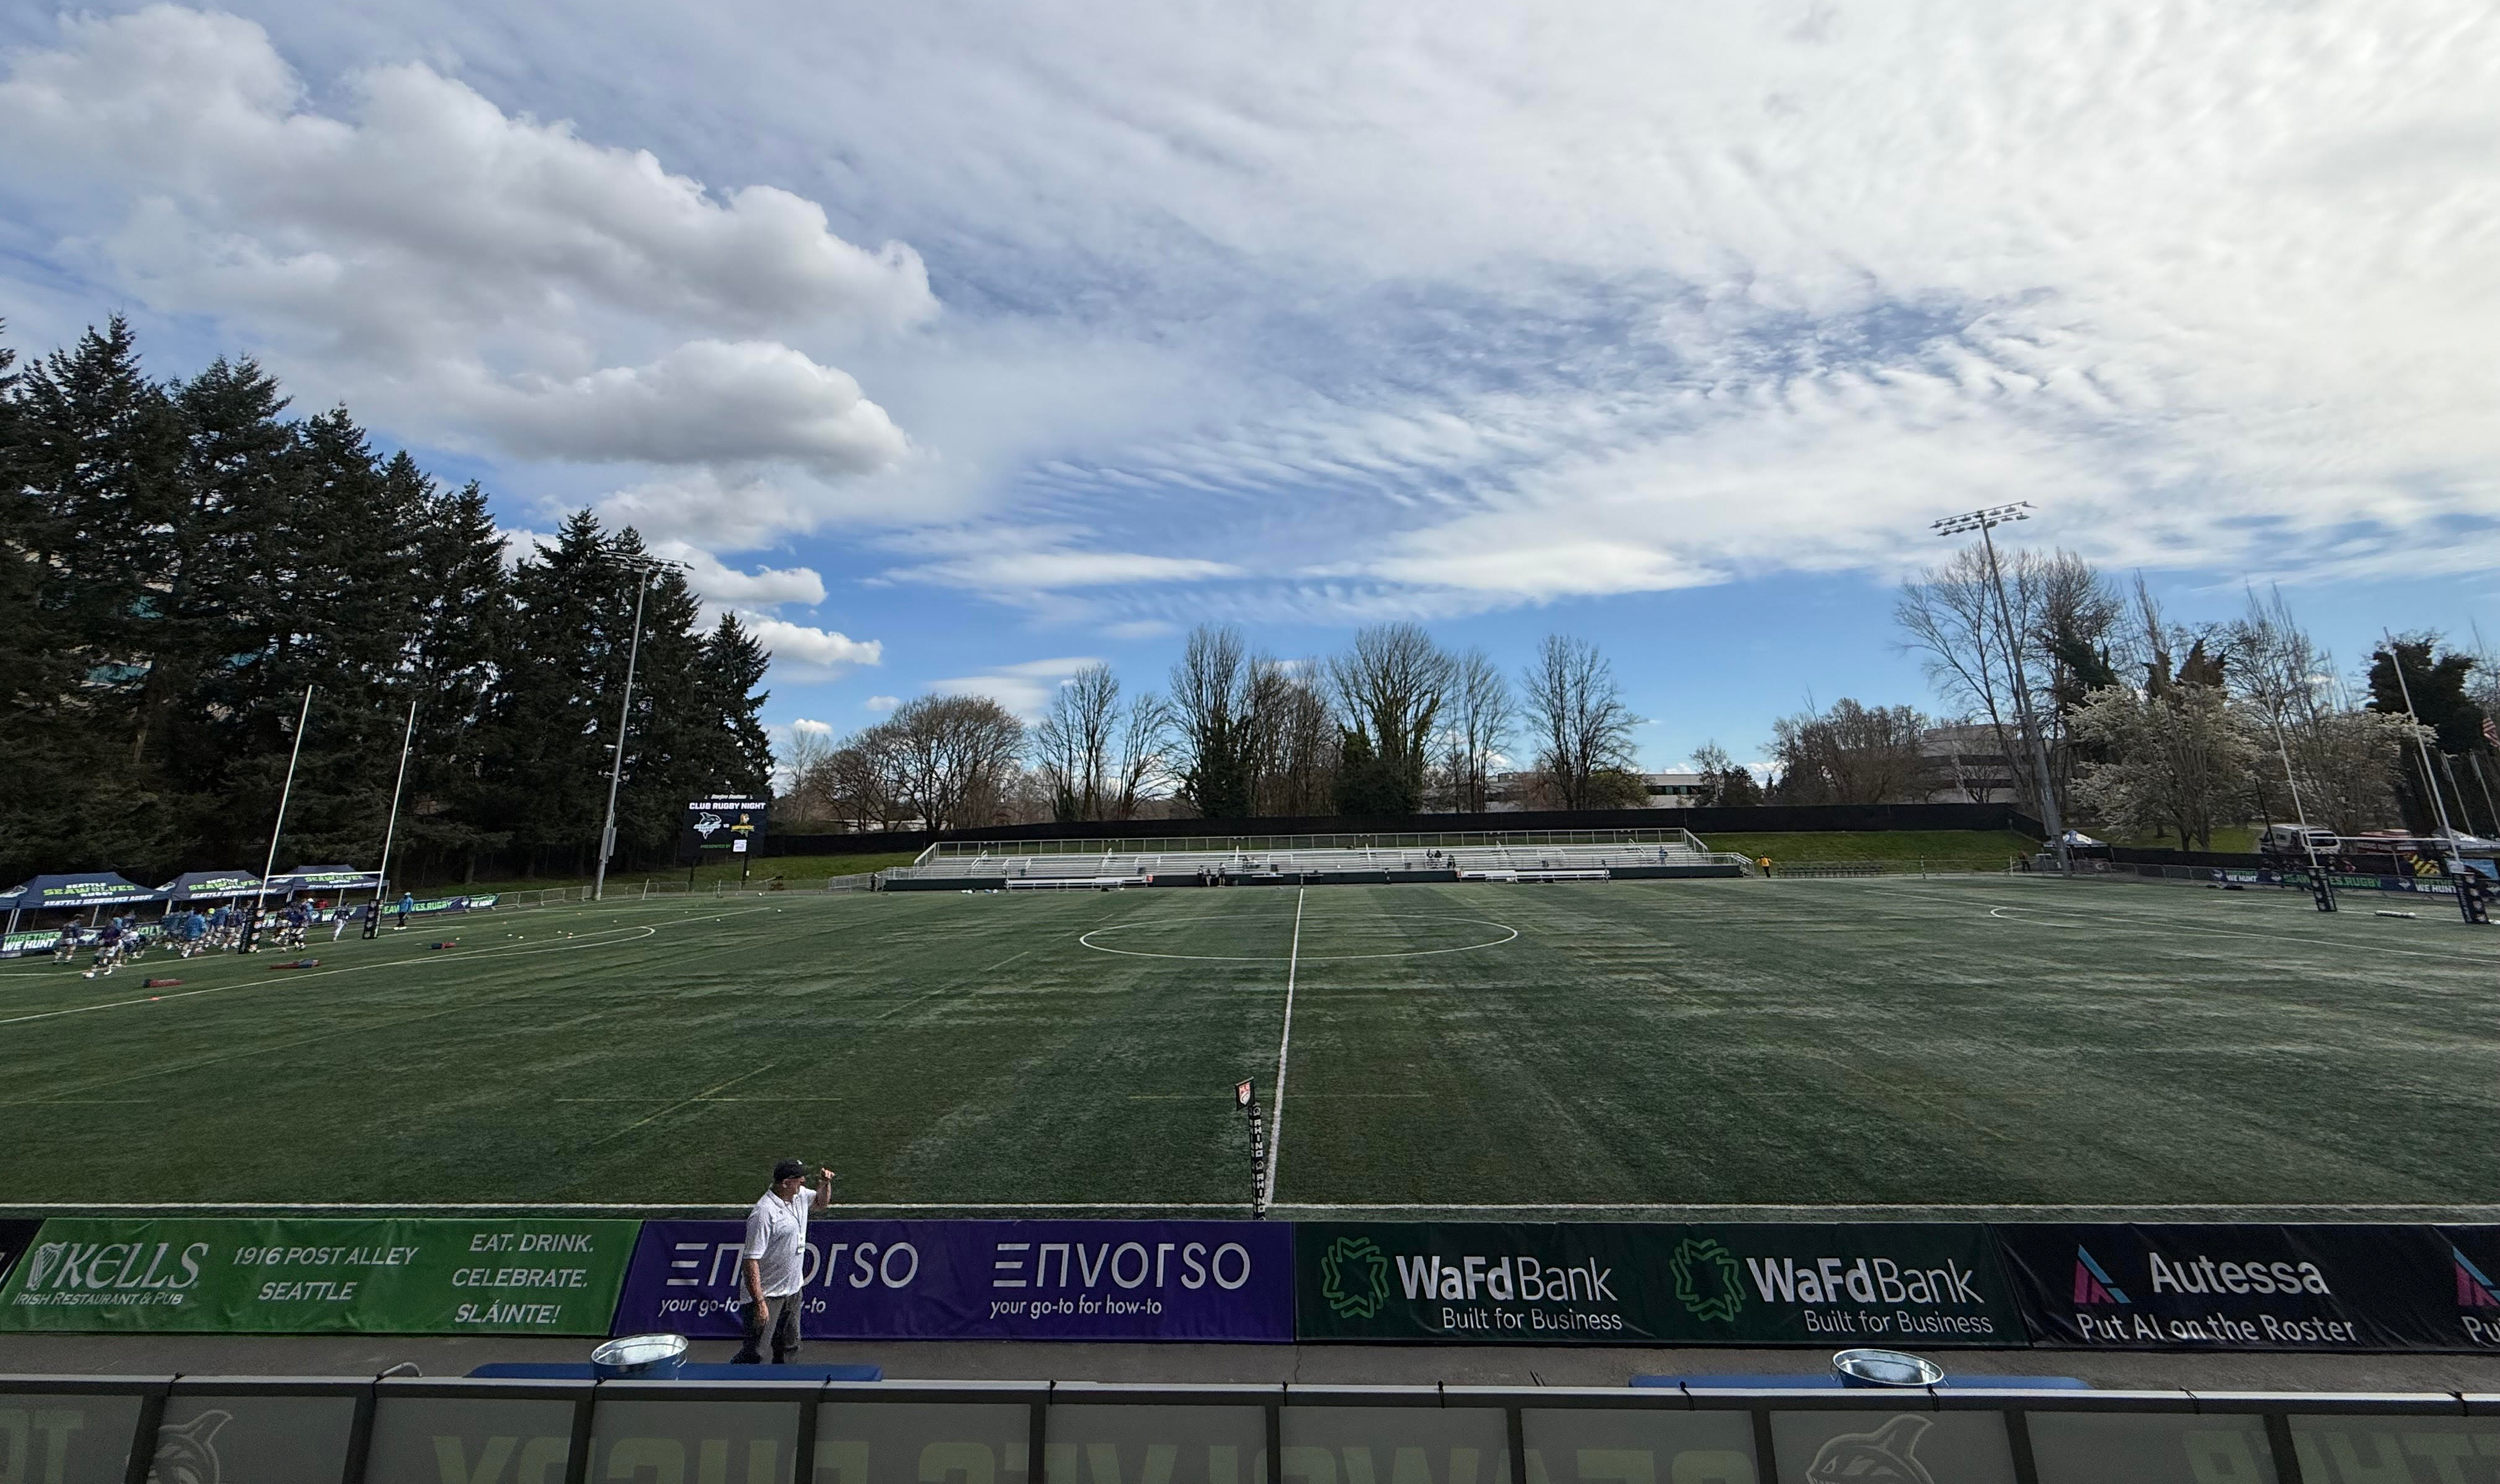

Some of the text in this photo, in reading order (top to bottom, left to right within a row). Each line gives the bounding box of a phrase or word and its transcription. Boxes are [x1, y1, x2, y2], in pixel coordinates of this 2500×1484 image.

[689, 802, 766, 810] CLUB RUGBY NIGHT
[2415, 883, 2430, 892] WE
[2, 939, 57, 951] WE HUNT
[1254, 1118, 1264, 1158] RHINO
[469, 1233, 594, 1252] EAT. DRINK.
[52, 1242, 209, 1289] KELLS
[233, 1246, 420, 1265] 1916 POST ALLEY
[452, 1268, 588, 1288] CELEBRATE.
[2148, 1252, 2331, 1295] Autessa
[52, 1291, 142, 1306] RESTAURANT
[141, 1292, 152, 1305] &
[152, 1292, 184, 1305] PUB
[258, 1281, 358, 1301] SEATTLE
[454, 1299, 561, 1324] SLÁINTE!
[658, 1297, 697, 1317] your
[698, 1297, 740, 1317] go-to
[990, 1294, 1162, 1319] your go-to for how-to
[1442, 1307, 1623, 1331] Built for Business
[1803, 1309, 1994, 1334] Built for Business
[2075, 1312, 2129, 1343] Put
[2169, 1319, 2207, 1340] on
[2207, 1312, 2260, 1341] the
[2258, 1314, 2357, 1342] Roster
